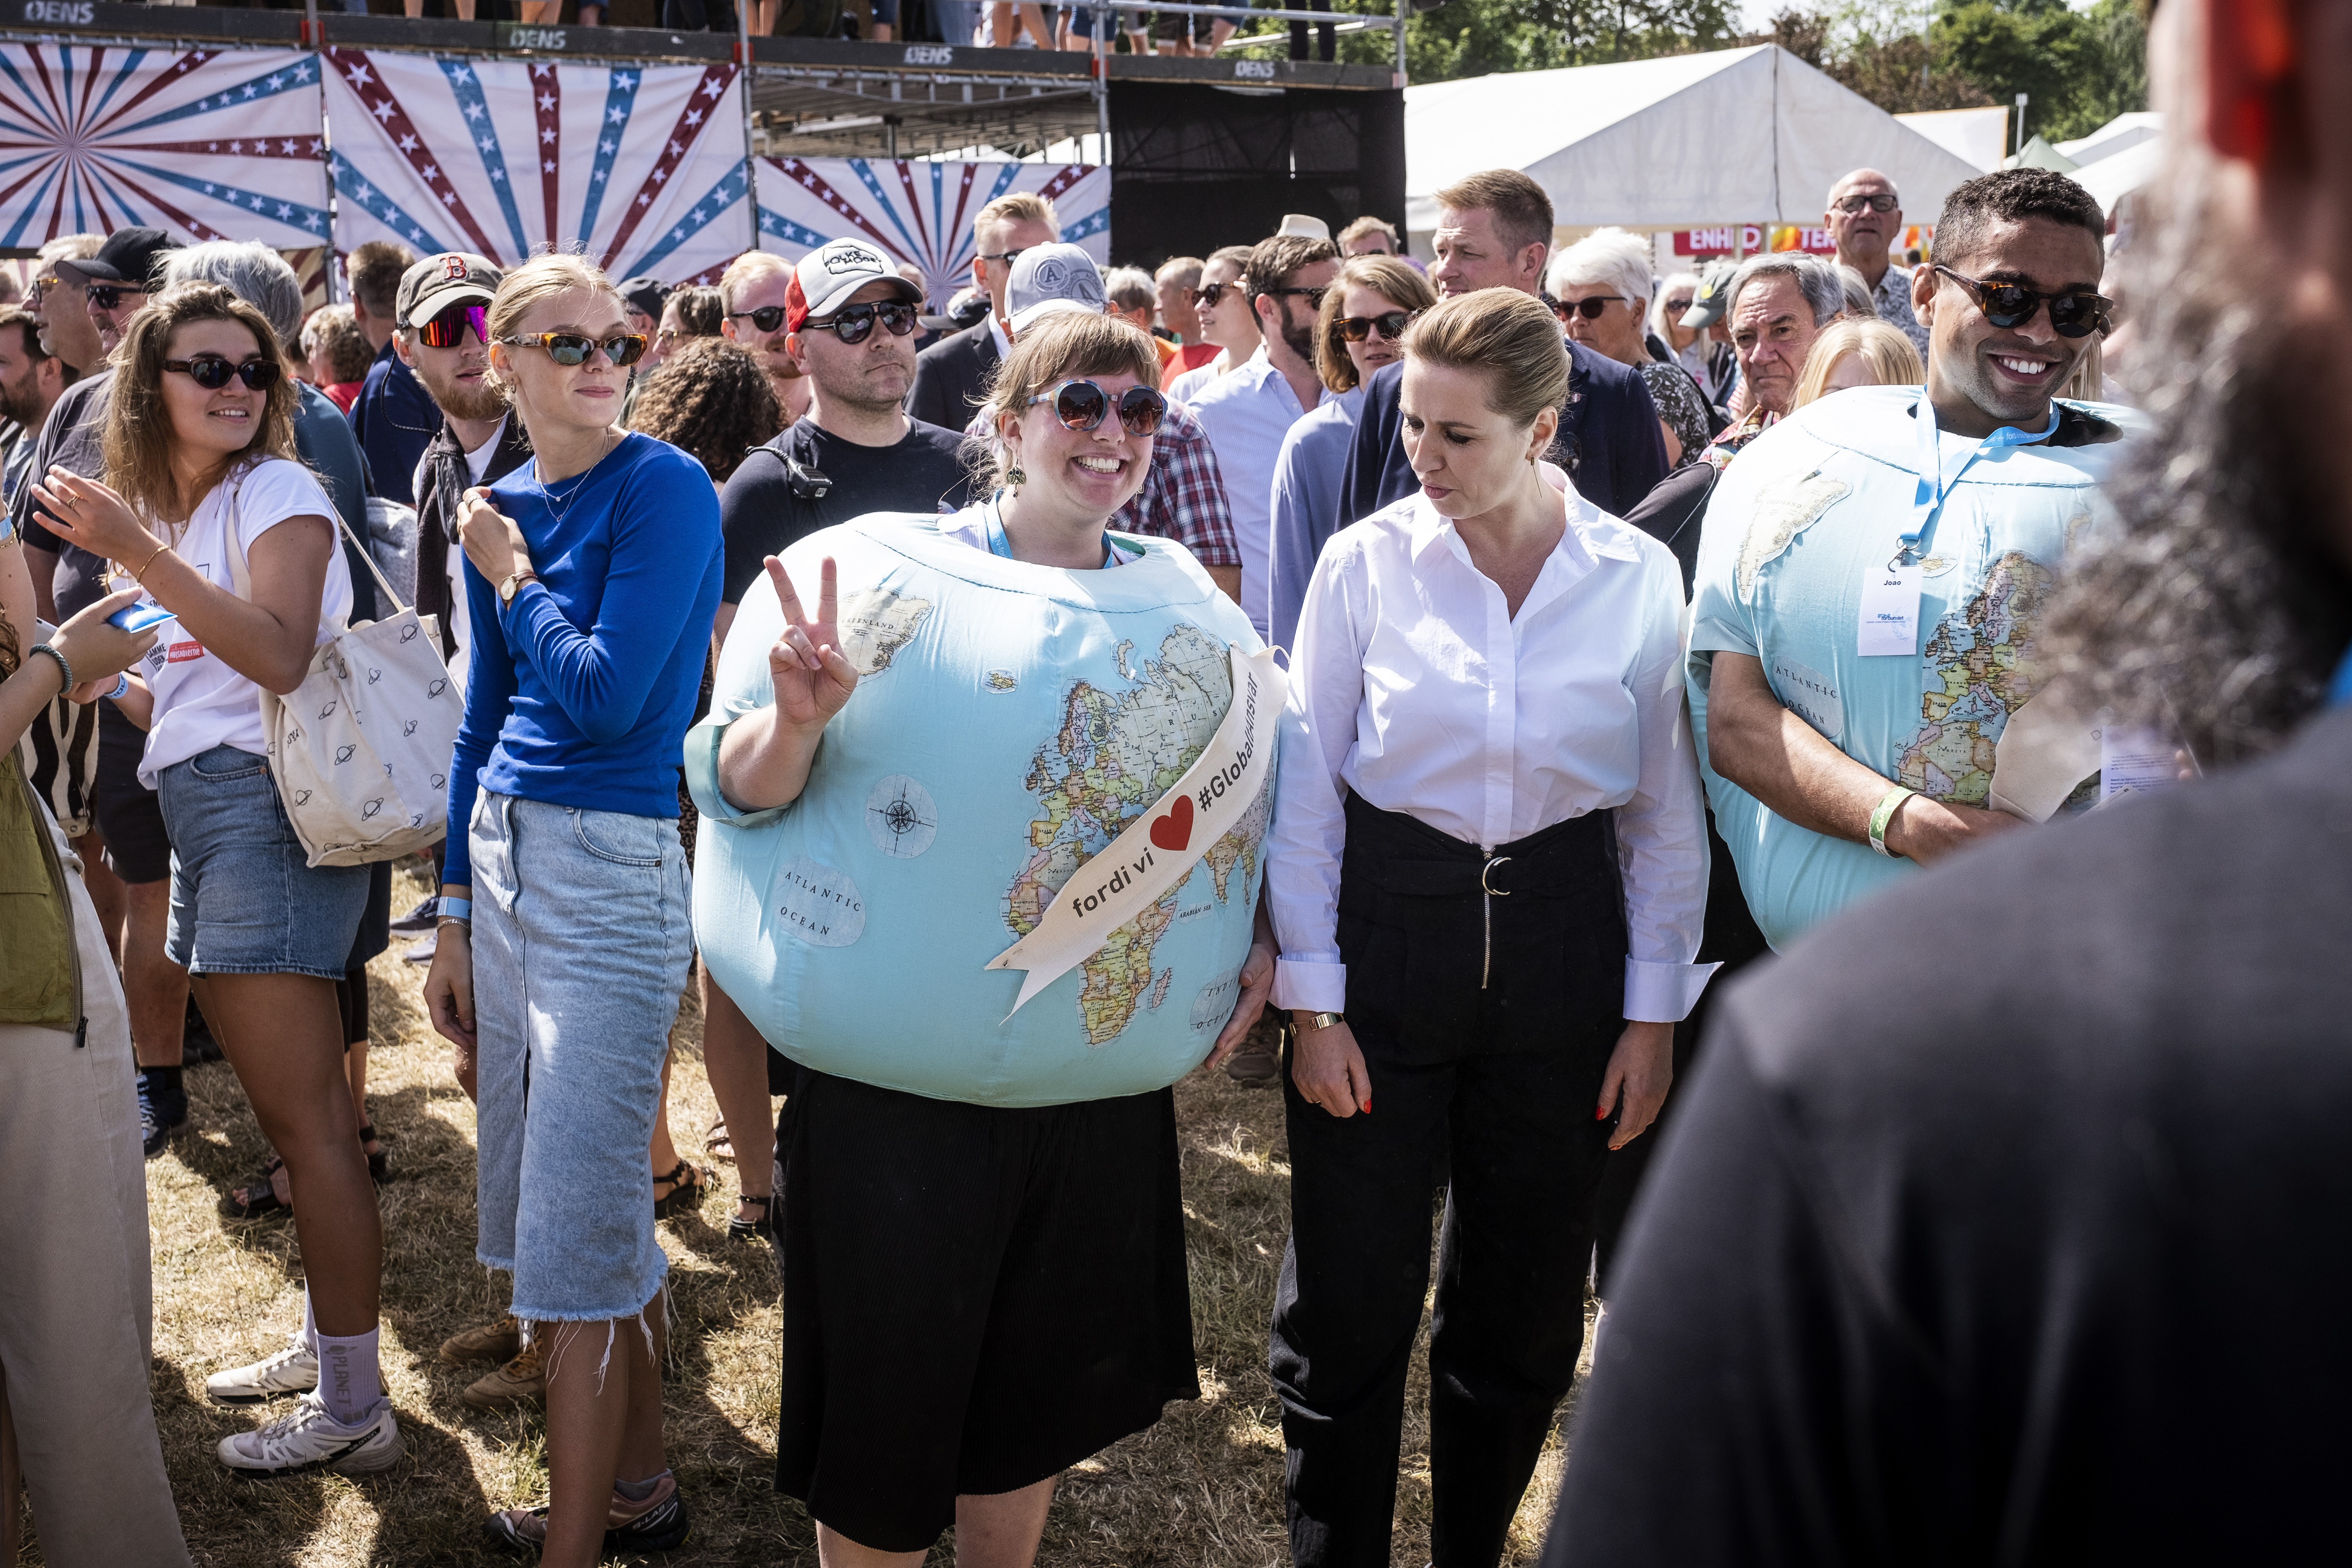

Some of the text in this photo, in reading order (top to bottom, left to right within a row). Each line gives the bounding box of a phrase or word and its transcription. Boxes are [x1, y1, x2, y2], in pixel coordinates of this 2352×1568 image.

[439, 256, 468, 280] B
[1043, 266, 1061, 283] A
[842, 618, 894, 629] GREENLAND
[1776, 666, 1837, 698] ATLANTIC
[1788, 700, 1824, 724] OCEAN
[785, 871, 861, 911] ATLANTIC
[1073, 865, 1131, 918] fordi
[1133, 847, 1154, 874] vi
[780, 906, 829, 935] OCEAN
[1179, 907, 1202, 919] ARABIAN
[332, 1357, 351, 1406] PLANET
